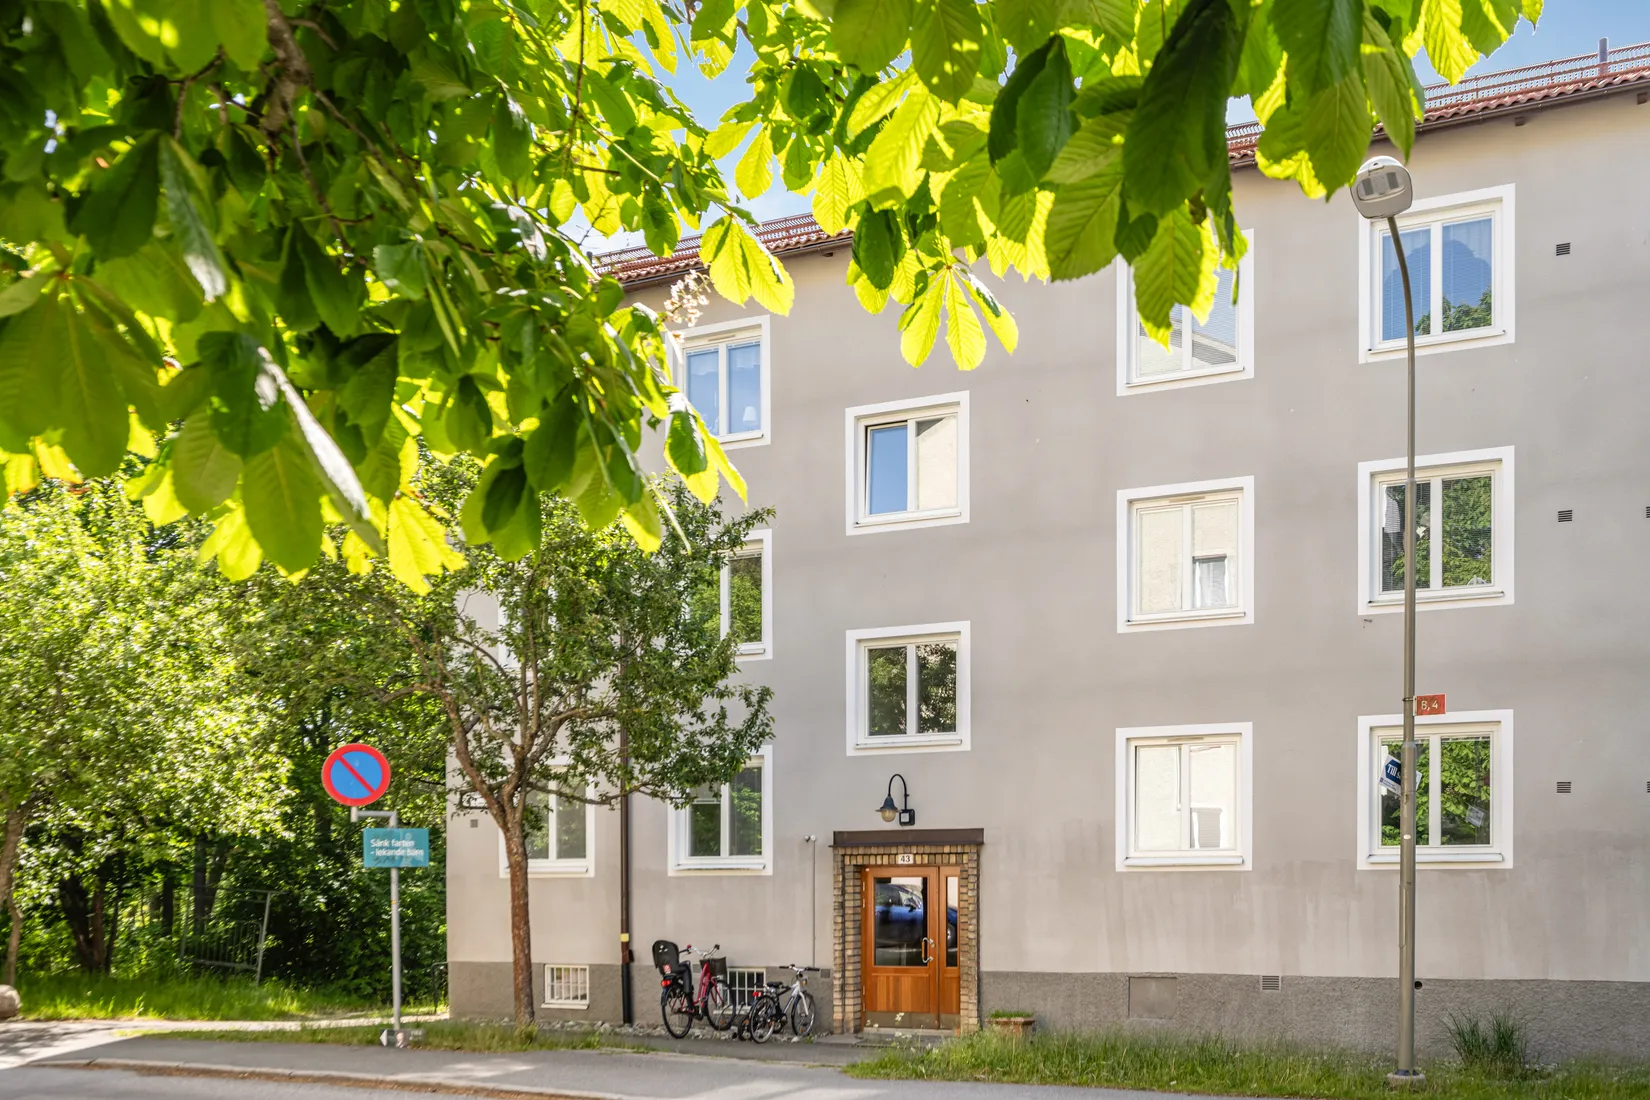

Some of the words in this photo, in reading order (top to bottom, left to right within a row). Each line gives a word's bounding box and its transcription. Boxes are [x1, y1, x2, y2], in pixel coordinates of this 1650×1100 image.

[1387, 763, 1398, 777] Till
[391, 839, 415, 848] farten
[406, 848, 425, 857] barn
[900, 855, 911, 863] 43
